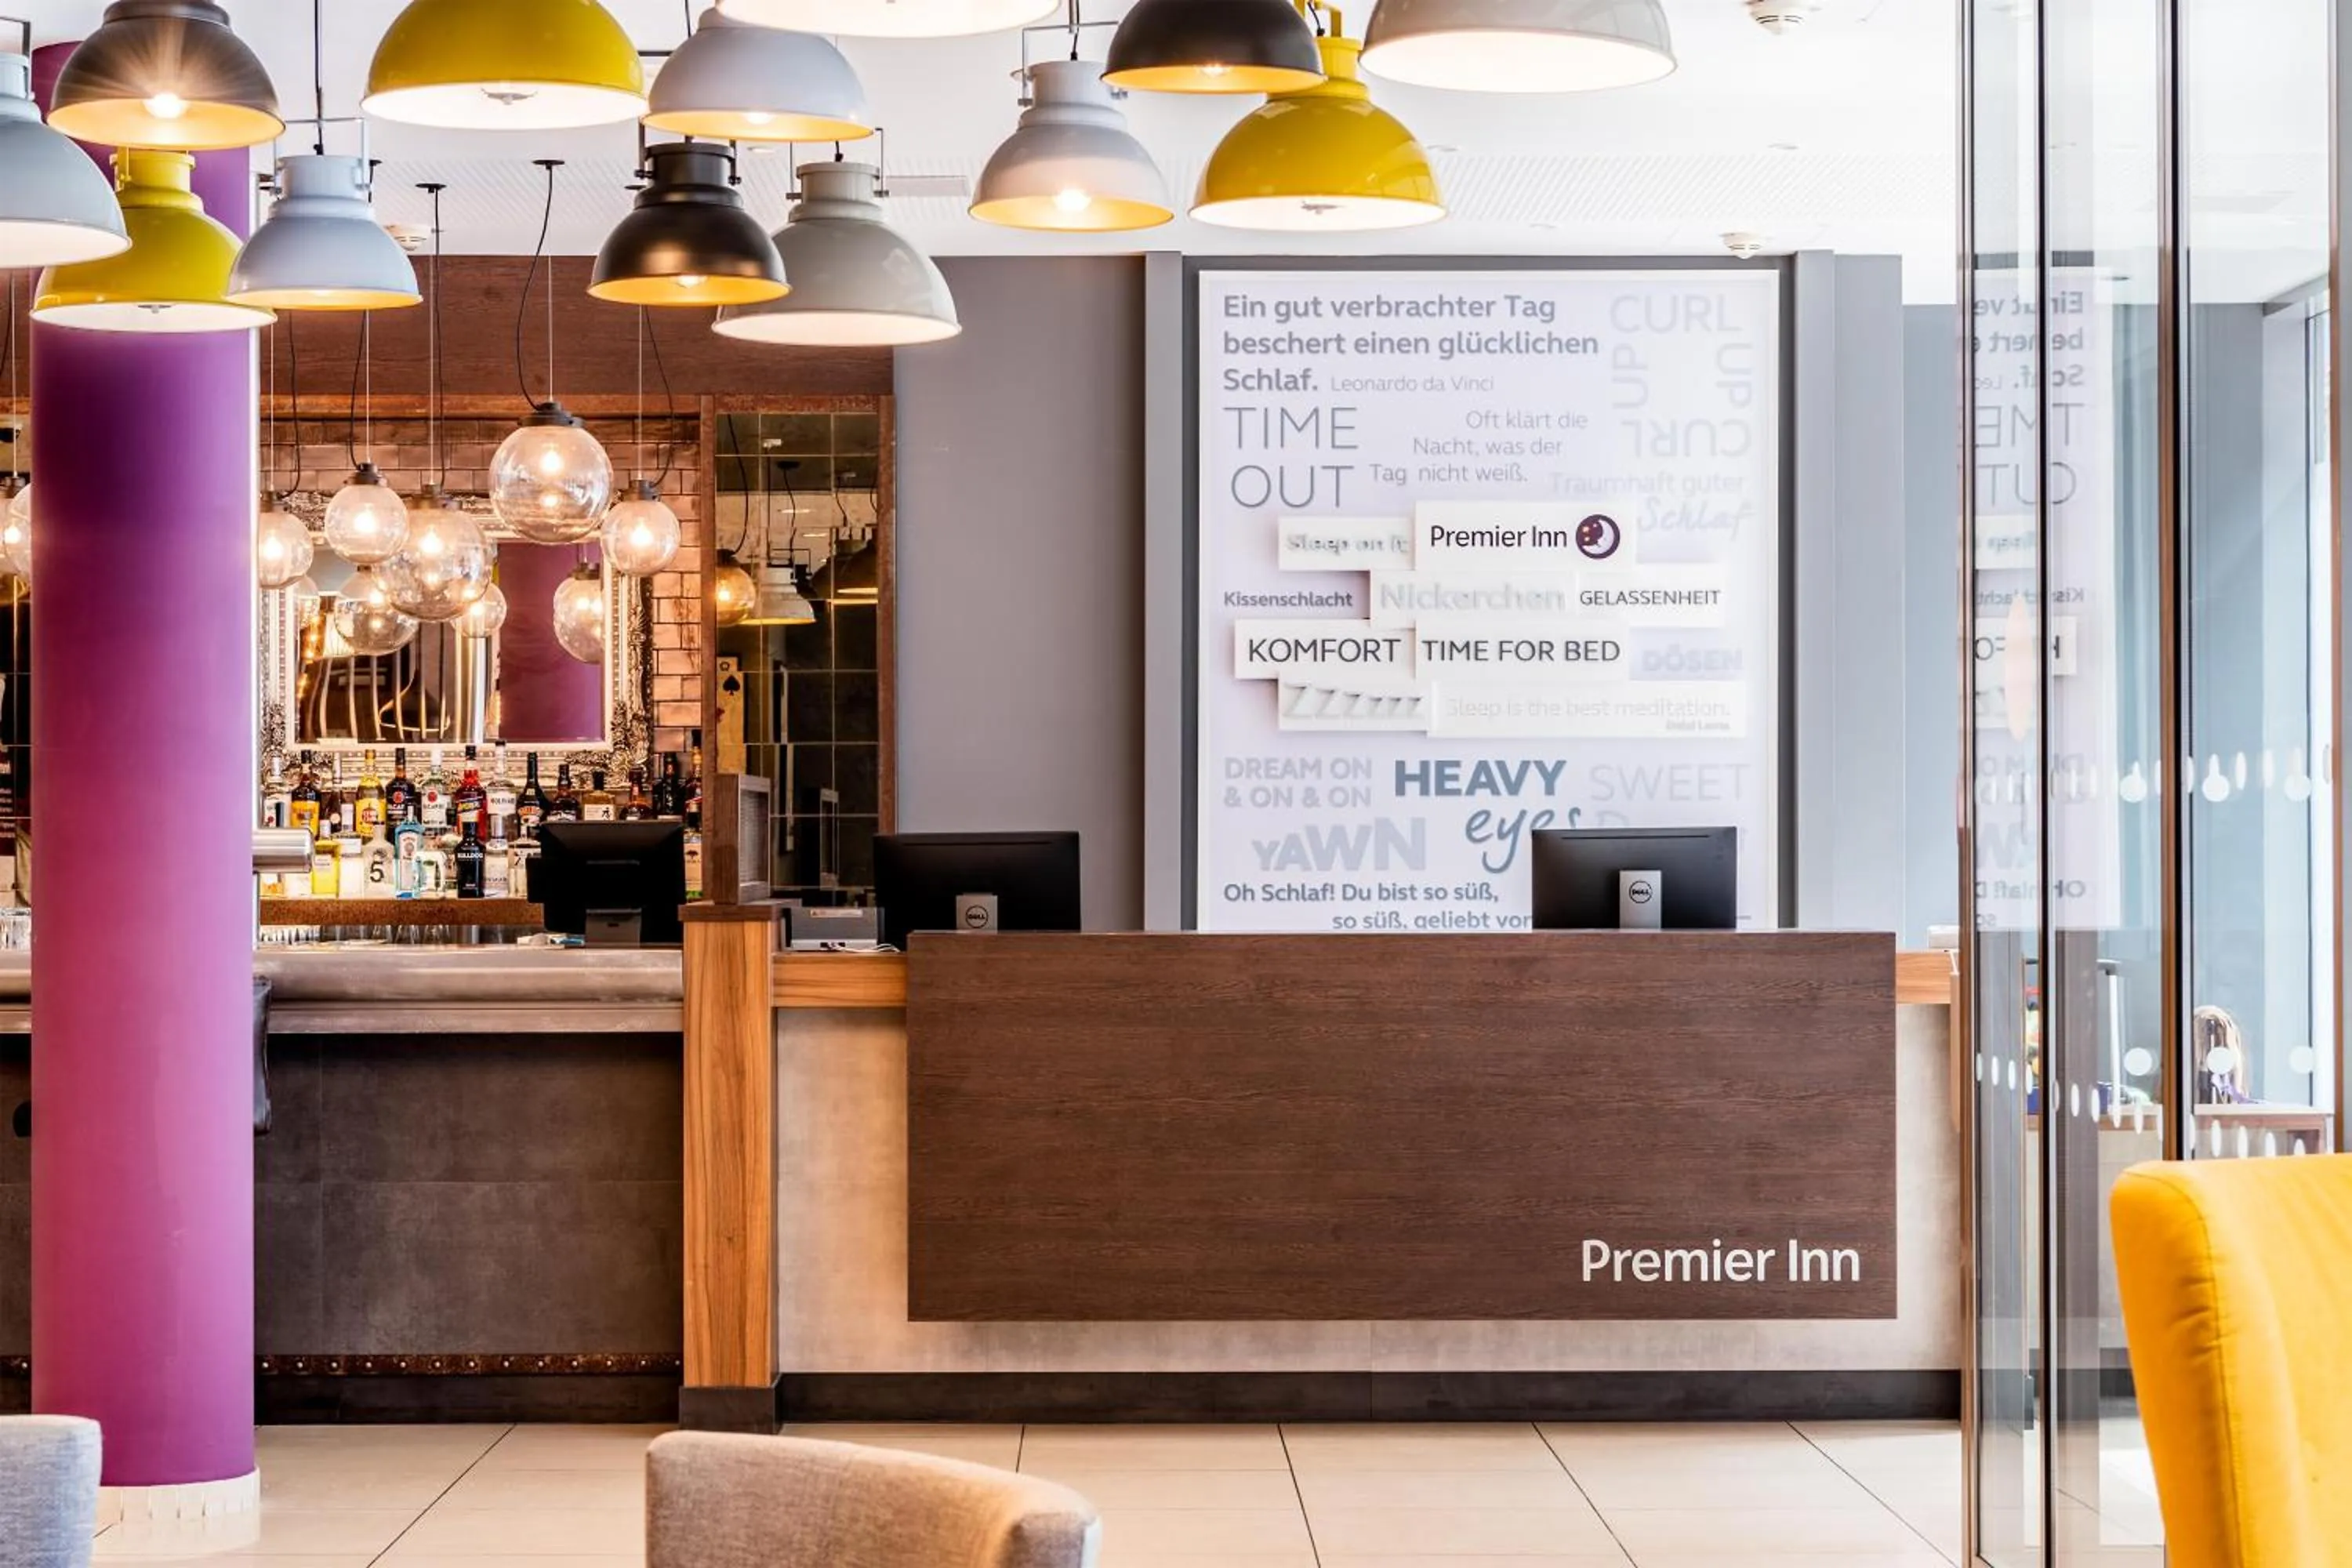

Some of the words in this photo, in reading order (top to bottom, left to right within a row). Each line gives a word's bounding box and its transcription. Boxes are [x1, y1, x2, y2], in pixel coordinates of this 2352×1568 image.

[1223, 293, 1267, 318] Ein
[1273, 296, 1323, 325] gut
[1330, 293, 1497, 318] verbrachter
[1503, 293, 1556, 324] Tag
[1610, 293, 1743, 333] CURL
[1223, 330, 1347, 355] beschert
[1353, 330, 1430, 355] einen
[1438, 330, 1599, 360] glücklichen
[1222, 368, 1318, 392] Schlaf.
[1331, 376, 1418, 392] Leonardo
[1422, 376, 1445, 392] da
[1450, 376, 1494, 392] Vinci
[1612, 343, 1649, 409] UP
[1716, 343, 1753, 408] UP
[1222, 406, 1359, 450] TIME
[1465, 409, 1499, 430] Oft
[1558, 408, 1589, 430] die
[1413, 436, 1480, 457] Nacht,
[1486, 440, 1525, 456] was
[1530, 436, 1564, 456] der
[1621, 419, 1751, 457] CURL
[1370, 463, 1407, 485] Tag
[1417, 463, 1468, 483] nicht
[1475, 463, 1529, 483] weiß.
[1682, 473, 1744, 497] guter
[1230, 464, 1356, 509] OUT
[1430, 524, 1529, 549] Premier
[1533, 524, 1567, 548] Inn
[1223, 590, 1353, 608] Kissenschlacht
[1579, 589, 1721, 608] GELASSENHEIT
[1248, 637, 1402, 662] KOMFORT
[1422, 640, 1490, 662] TIME
[1498, 640, 1555, 662] FOR
[1565, 640, 1621, 662] BED
[1642, 644, 1742, 673] DÖSEN
[1449, 697, 1501, 720] Sleep
[1528, 697, 1560, 716] the
[1567, 697, 1609, 716] best
[1224, 757, 1323, 781] DREAM
[1330, 757, 1371, 780] ON
[1395, 759, 1568, 797] HEAVY
[1589, 763, 1751, 801] SWEET
[1223, 786, 1243, 808] &
[1250, 785, 1293, 808] ON
[1301, 786, 1322, 808] &
[1327, 785, 1371, 808] ON
[370, 861, 384, 883] 5
[1223, 883, 1255, 902] Oh
[1261, 882, 1335, 902] Schlaf!
[1341, 883, 1371, 902] Du
[1377, 882, 1418, 902] bist
[1423, 887, 1448, 902] so
[1453, 882, 1499, 904] süß,
[1333, 914, 1358, 929] so
[1582, 1238, 1776, 1282] Premier
[1788, 1239, 1860, 1282] Inn
